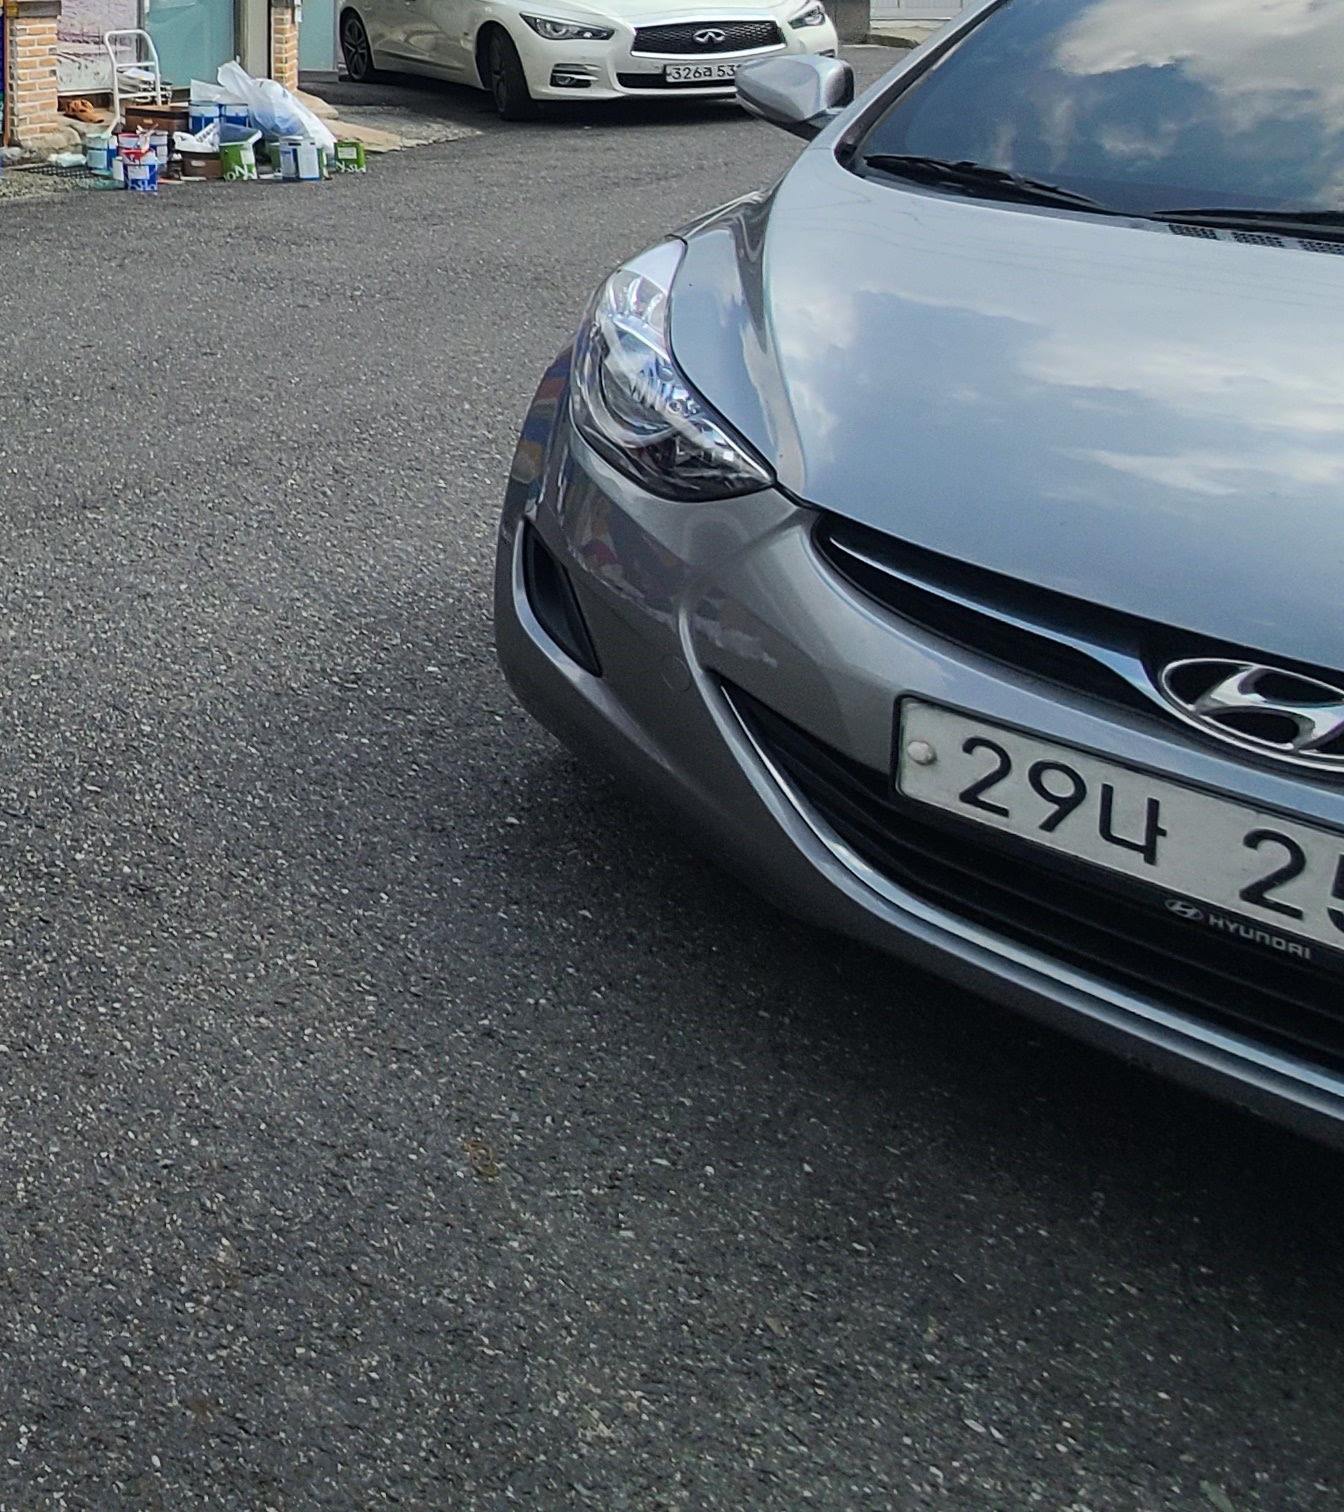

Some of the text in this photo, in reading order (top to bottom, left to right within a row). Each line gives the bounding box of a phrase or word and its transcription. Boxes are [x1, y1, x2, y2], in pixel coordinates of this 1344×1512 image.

[958, 736, 1344, 935] 29나 2
[1208, 913, 1311, 960] HYUNDAI
